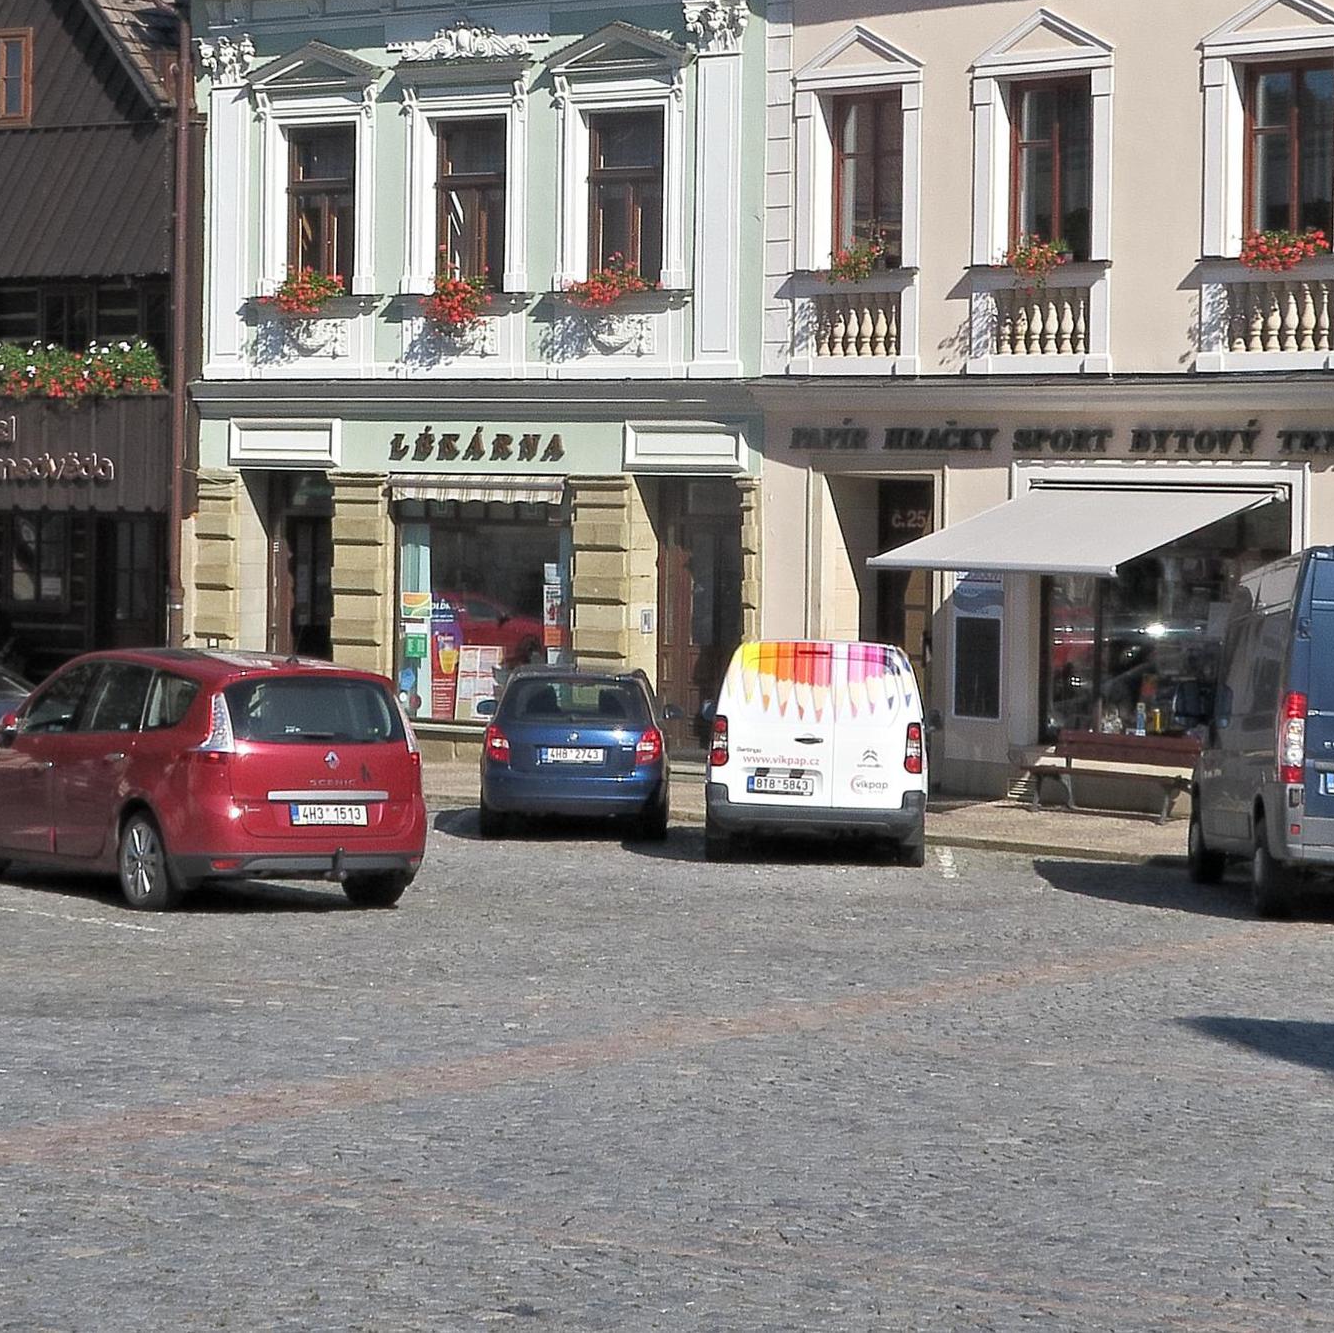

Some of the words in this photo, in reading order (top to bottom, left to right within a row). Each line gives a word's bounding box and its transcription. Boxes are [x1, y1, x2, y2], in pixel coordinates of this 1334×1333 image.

[789, 417, 869, 449] PAPÍR
[882, 420, 1000, 451] HRAČKY
[1012, 428, 1113, 452] SPORT
[1128, 419, 1261, 454] BYTOVÝ
[388, 425, 565, 462] LÉKÁRNA
[575, 749, 599, 759] 2743
[783, 779, 809, 791] 5843
[302, 806, 324, 820] 4H3
[334, 807, 361, 820] 1513
